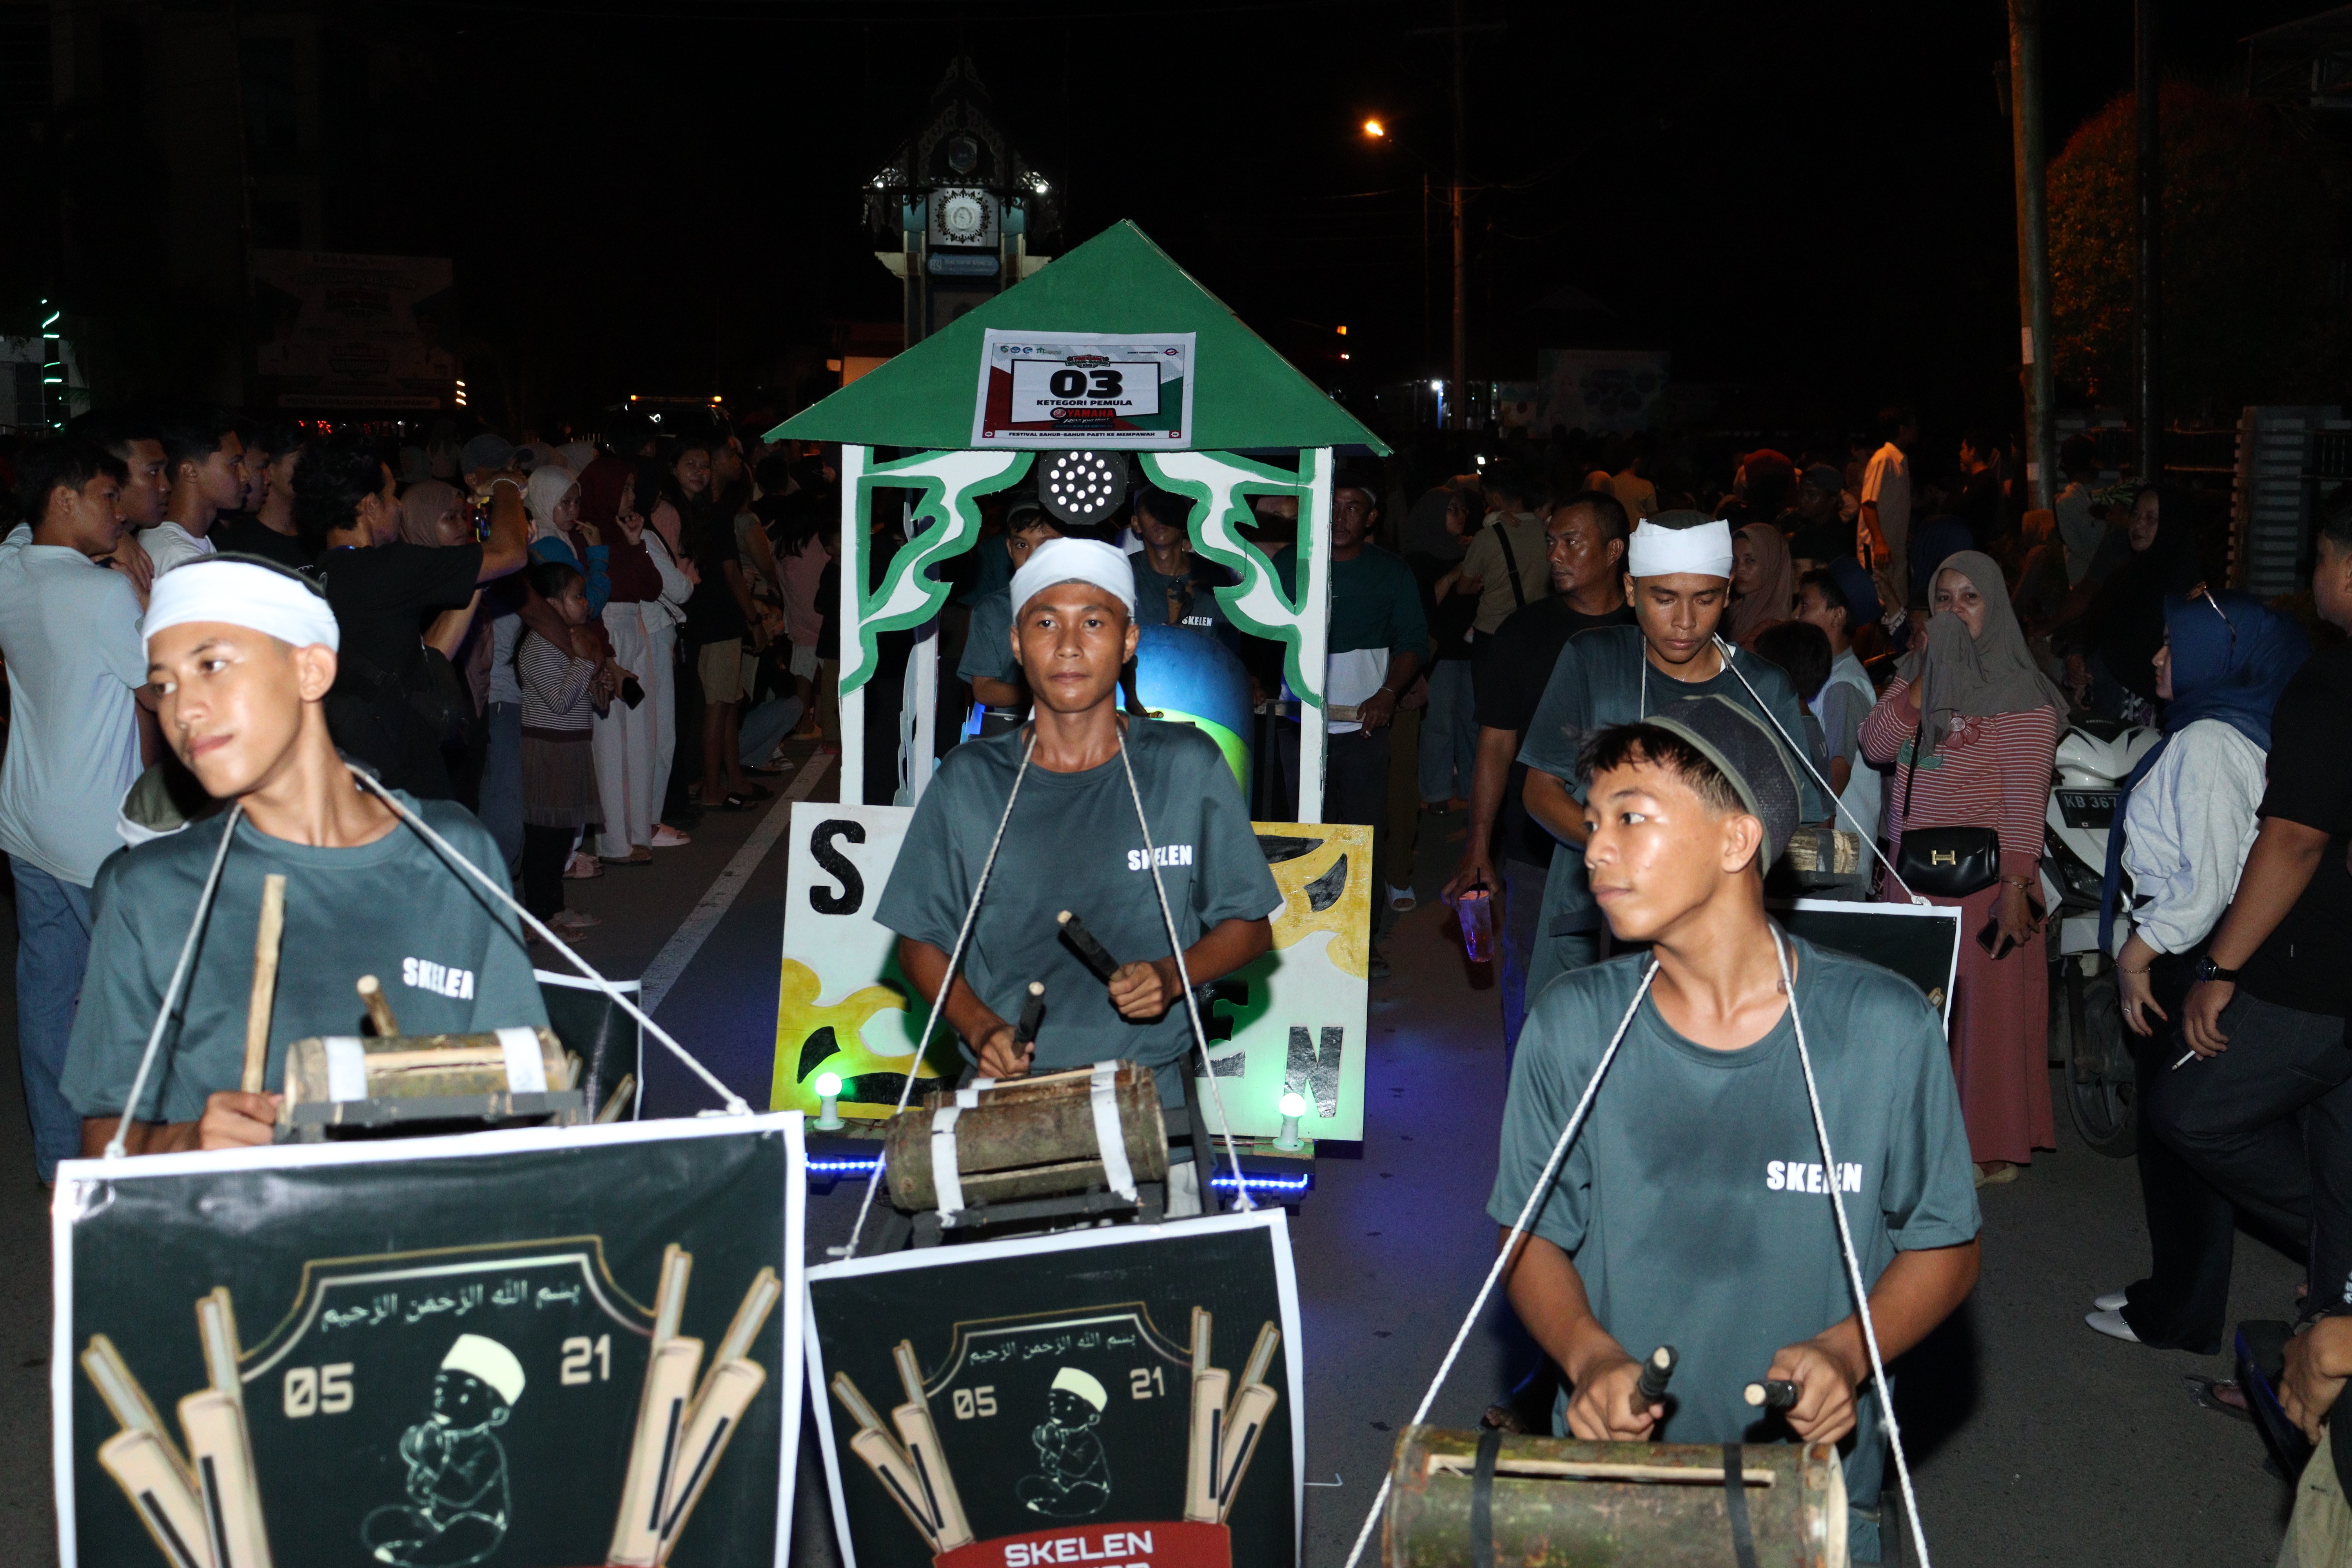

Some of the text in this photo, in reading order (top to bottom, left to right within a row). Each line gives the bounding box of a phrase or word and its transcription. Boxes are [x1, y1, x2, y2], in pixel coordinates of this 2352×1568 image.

[1050, 369, 1123, 398] 03
[1181, 615, 1212, 626] SKELEN
[2064, 795, 2086, 808] KB
[284, 1334, 611, 1418] 05 21
[953, 1366, 1165, 1419] 05 21
[1004, 1530, 1153, 1568] SKELEN
